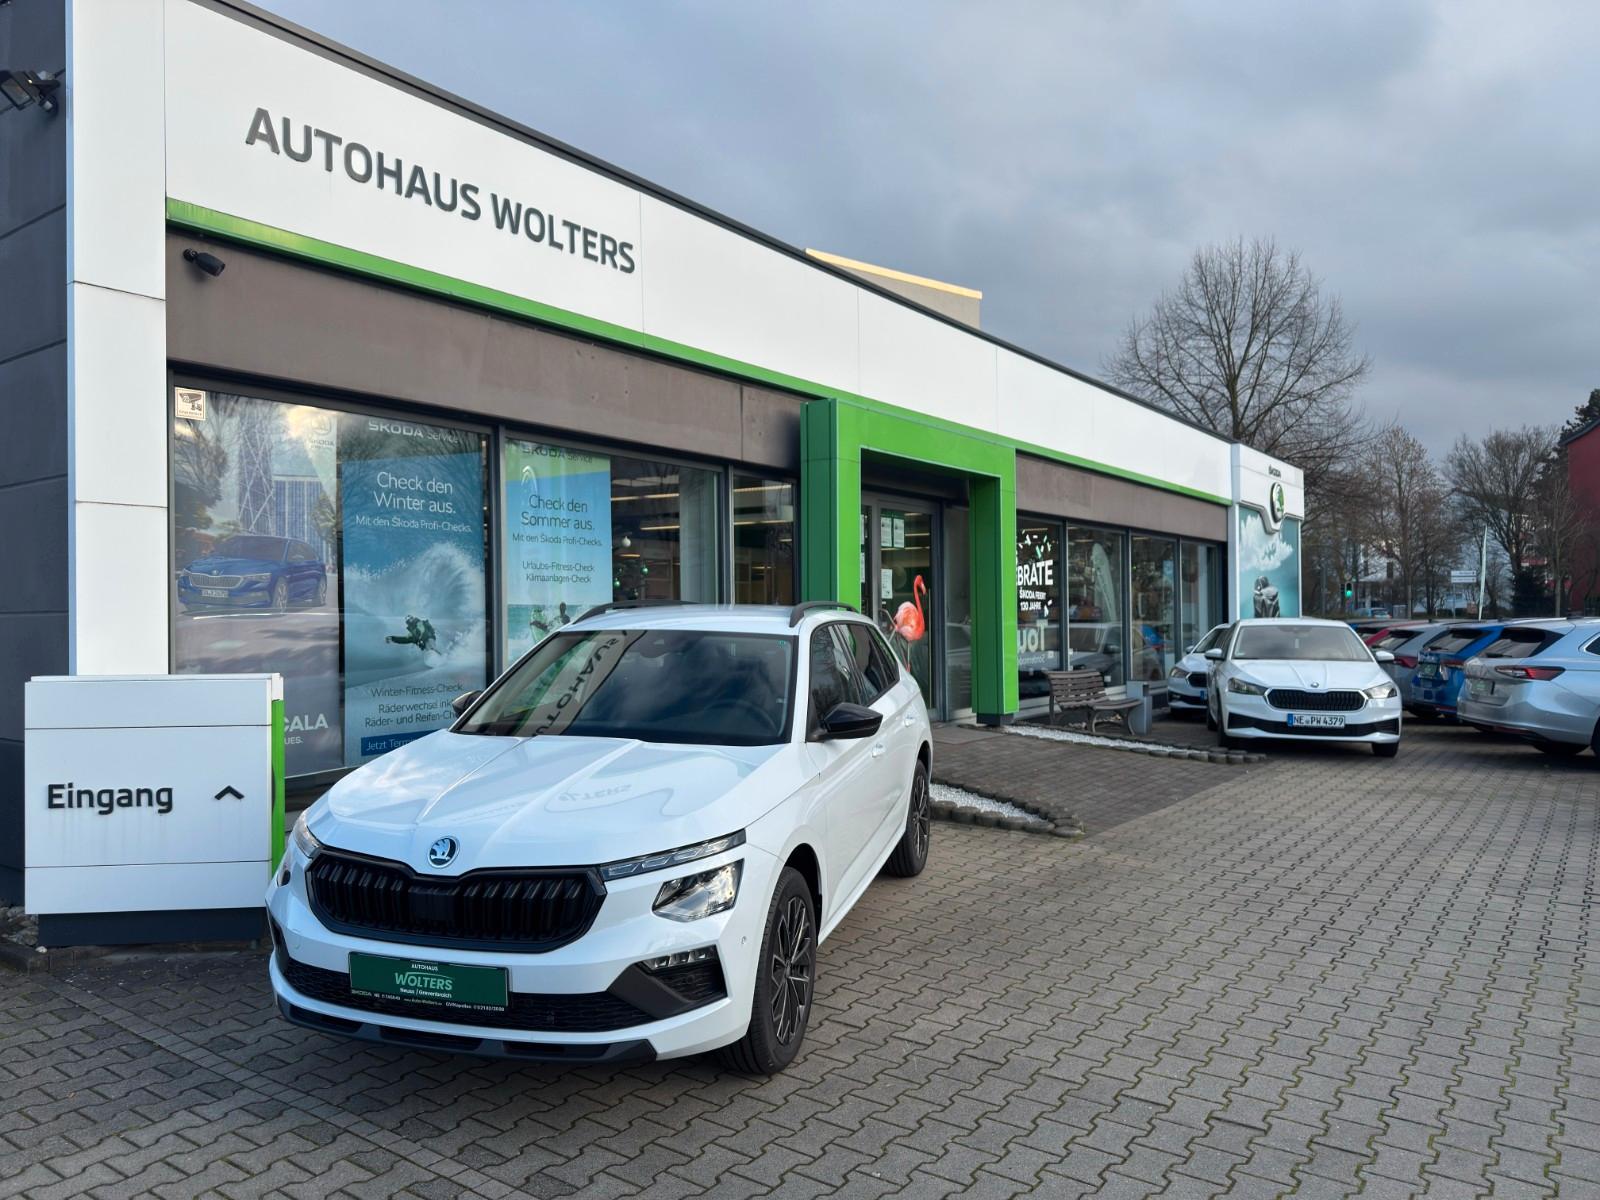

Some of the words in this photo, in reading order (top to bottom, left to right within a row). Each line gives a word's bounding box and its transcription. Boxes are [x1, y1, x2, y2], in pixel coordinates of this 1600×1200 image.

[245, 107, 481, 221] AUTOHAUS
[491, 193, 636, 274] WOLTERS
[376, 471, 423, 490] Check
[426, 478, 453, 494] den
[373, 491, 425, 510] Winter
[428, 499, 457, 514] aus.
[529, 494, 565, 510] Check
[567, 498, 588, 512] den
[356, 514, 372, 525] Mit
[373, 516, 390, 527] den
[521, 511, 571, 527] Sommer
[573, 517, 596, 531] aus.
[513, 533, 524, 542] Mit
[526, 533, 539, 543] den
[1016, 559, 1054, 586] BRATE
[396, 714, 413, 725] und
[1293, 715, 1304, 725] NE
[1322, 715, 1345, 727] 4379
[366, 740, 386, 752] Jetzt
[47, 782, 174, 815] Eingang
[411, 963, 439, 972] AUTOHAUS
[394, 971, 454, 991] WOLTERS
